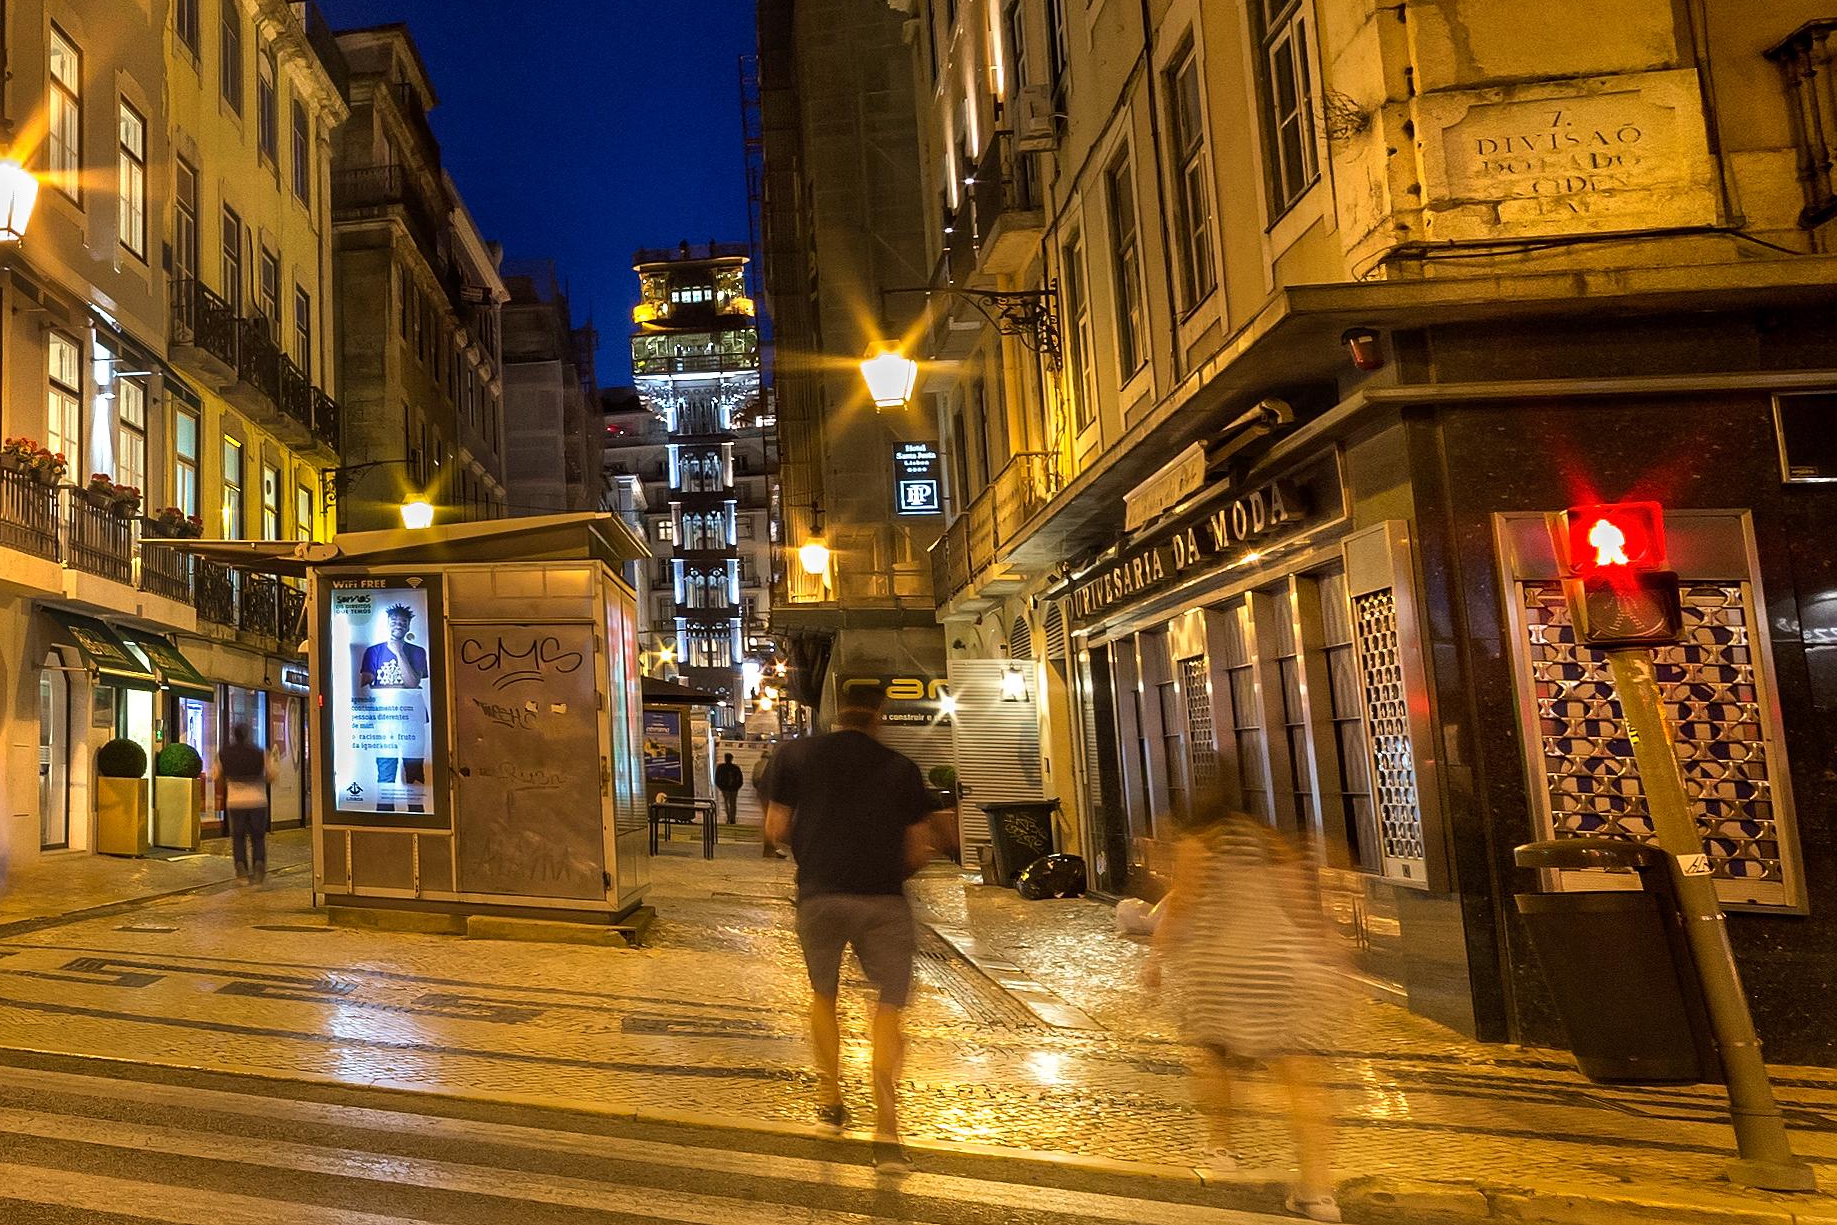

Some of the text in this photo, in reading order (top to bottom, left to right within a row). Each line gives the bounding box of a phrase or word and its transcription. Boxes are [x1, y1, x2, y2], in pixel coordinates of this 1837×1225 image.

[904, 444, 926, 452] Hotel
[1064, 548, 1164, 621] OURIVESARIA
[1172, 527, 1201, 571] DA
[1210, 482, 1288, 552] MODA
[361, 579, 386, 589] FREE
